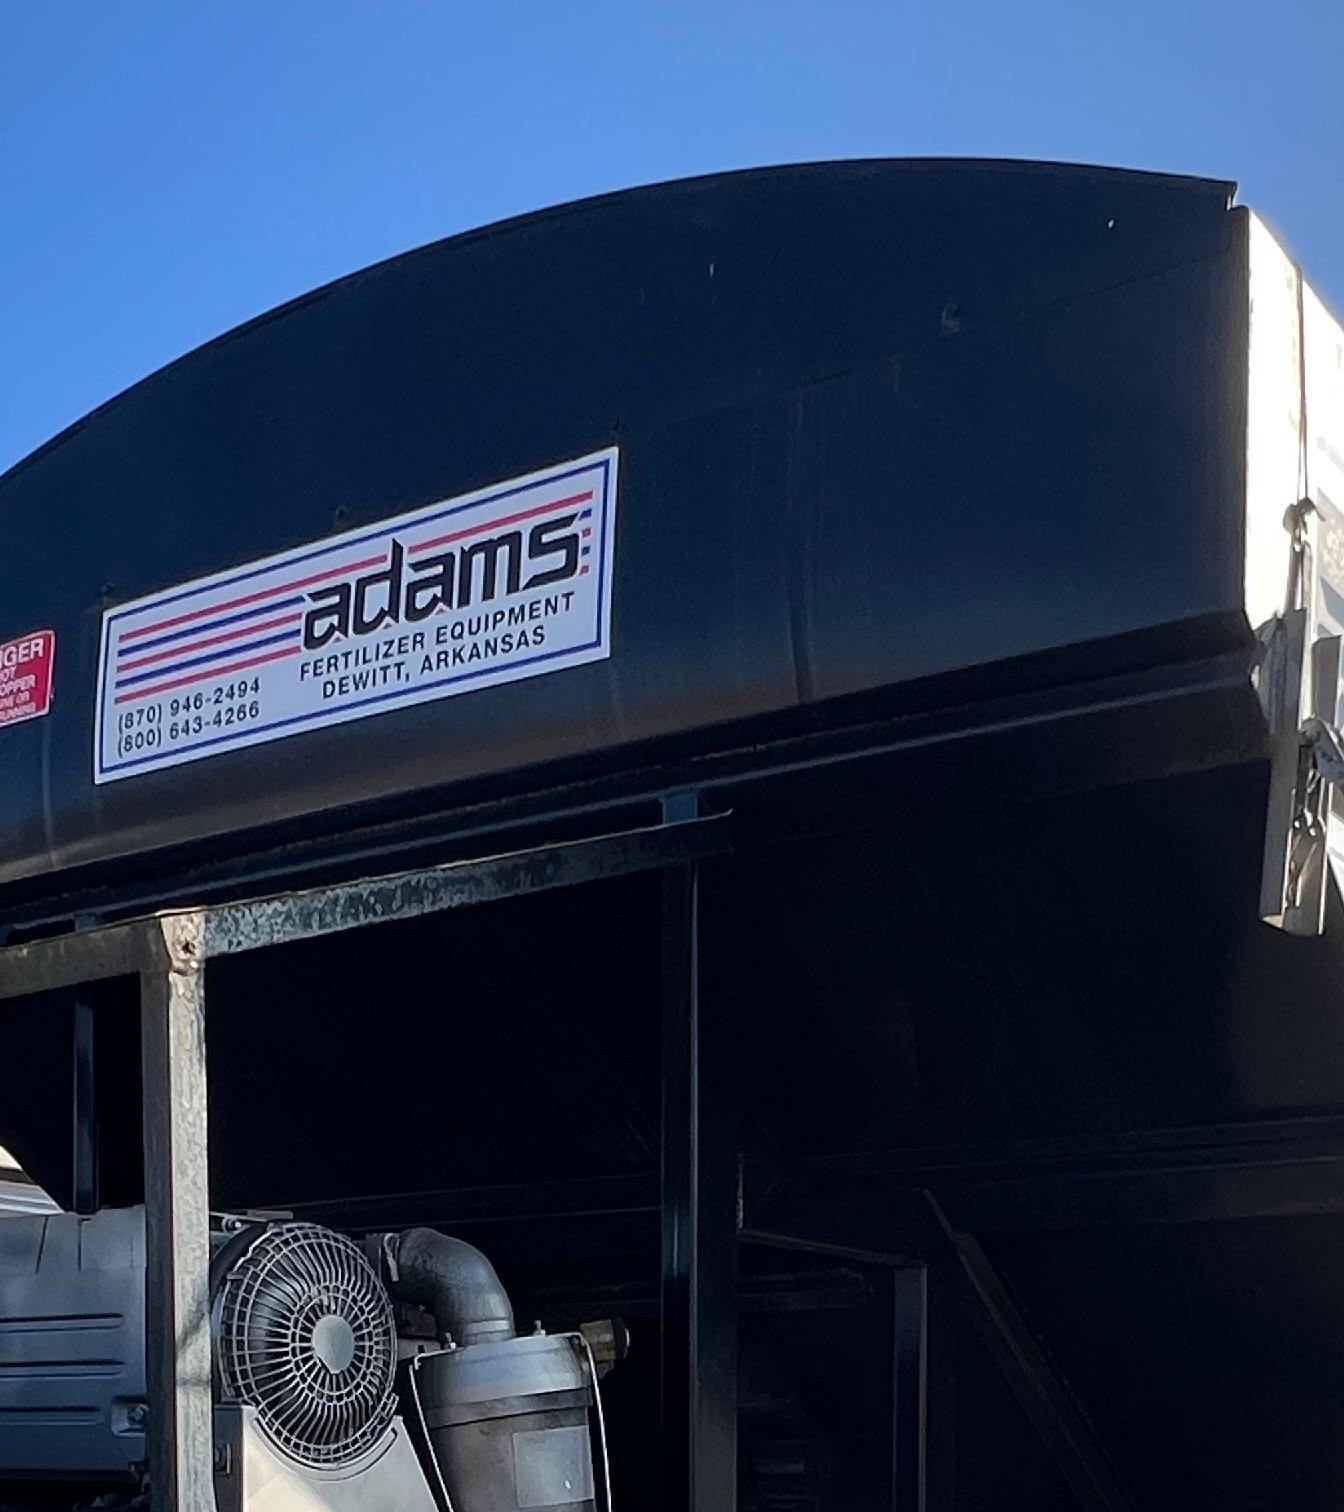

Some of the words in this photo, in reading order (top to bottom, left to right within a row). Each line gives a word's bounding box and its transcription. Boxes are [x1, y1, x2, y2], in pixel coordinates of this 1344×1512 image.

[302, 511, 580, 651] adams
[299, 632, 426, 681] FERTILIZER
[435, 591, 575, 646] EQUIPMENT
[322, 661, 410, 700] DEWITT,
[420, 625, 546, 675] ARKANSAS
[117, 726, 162, 758] (800)
[169, 700, 260, 740] 643-4266
[118, 703, 162, 735] (870)
[169, 676, 260, 717] 946-2494
